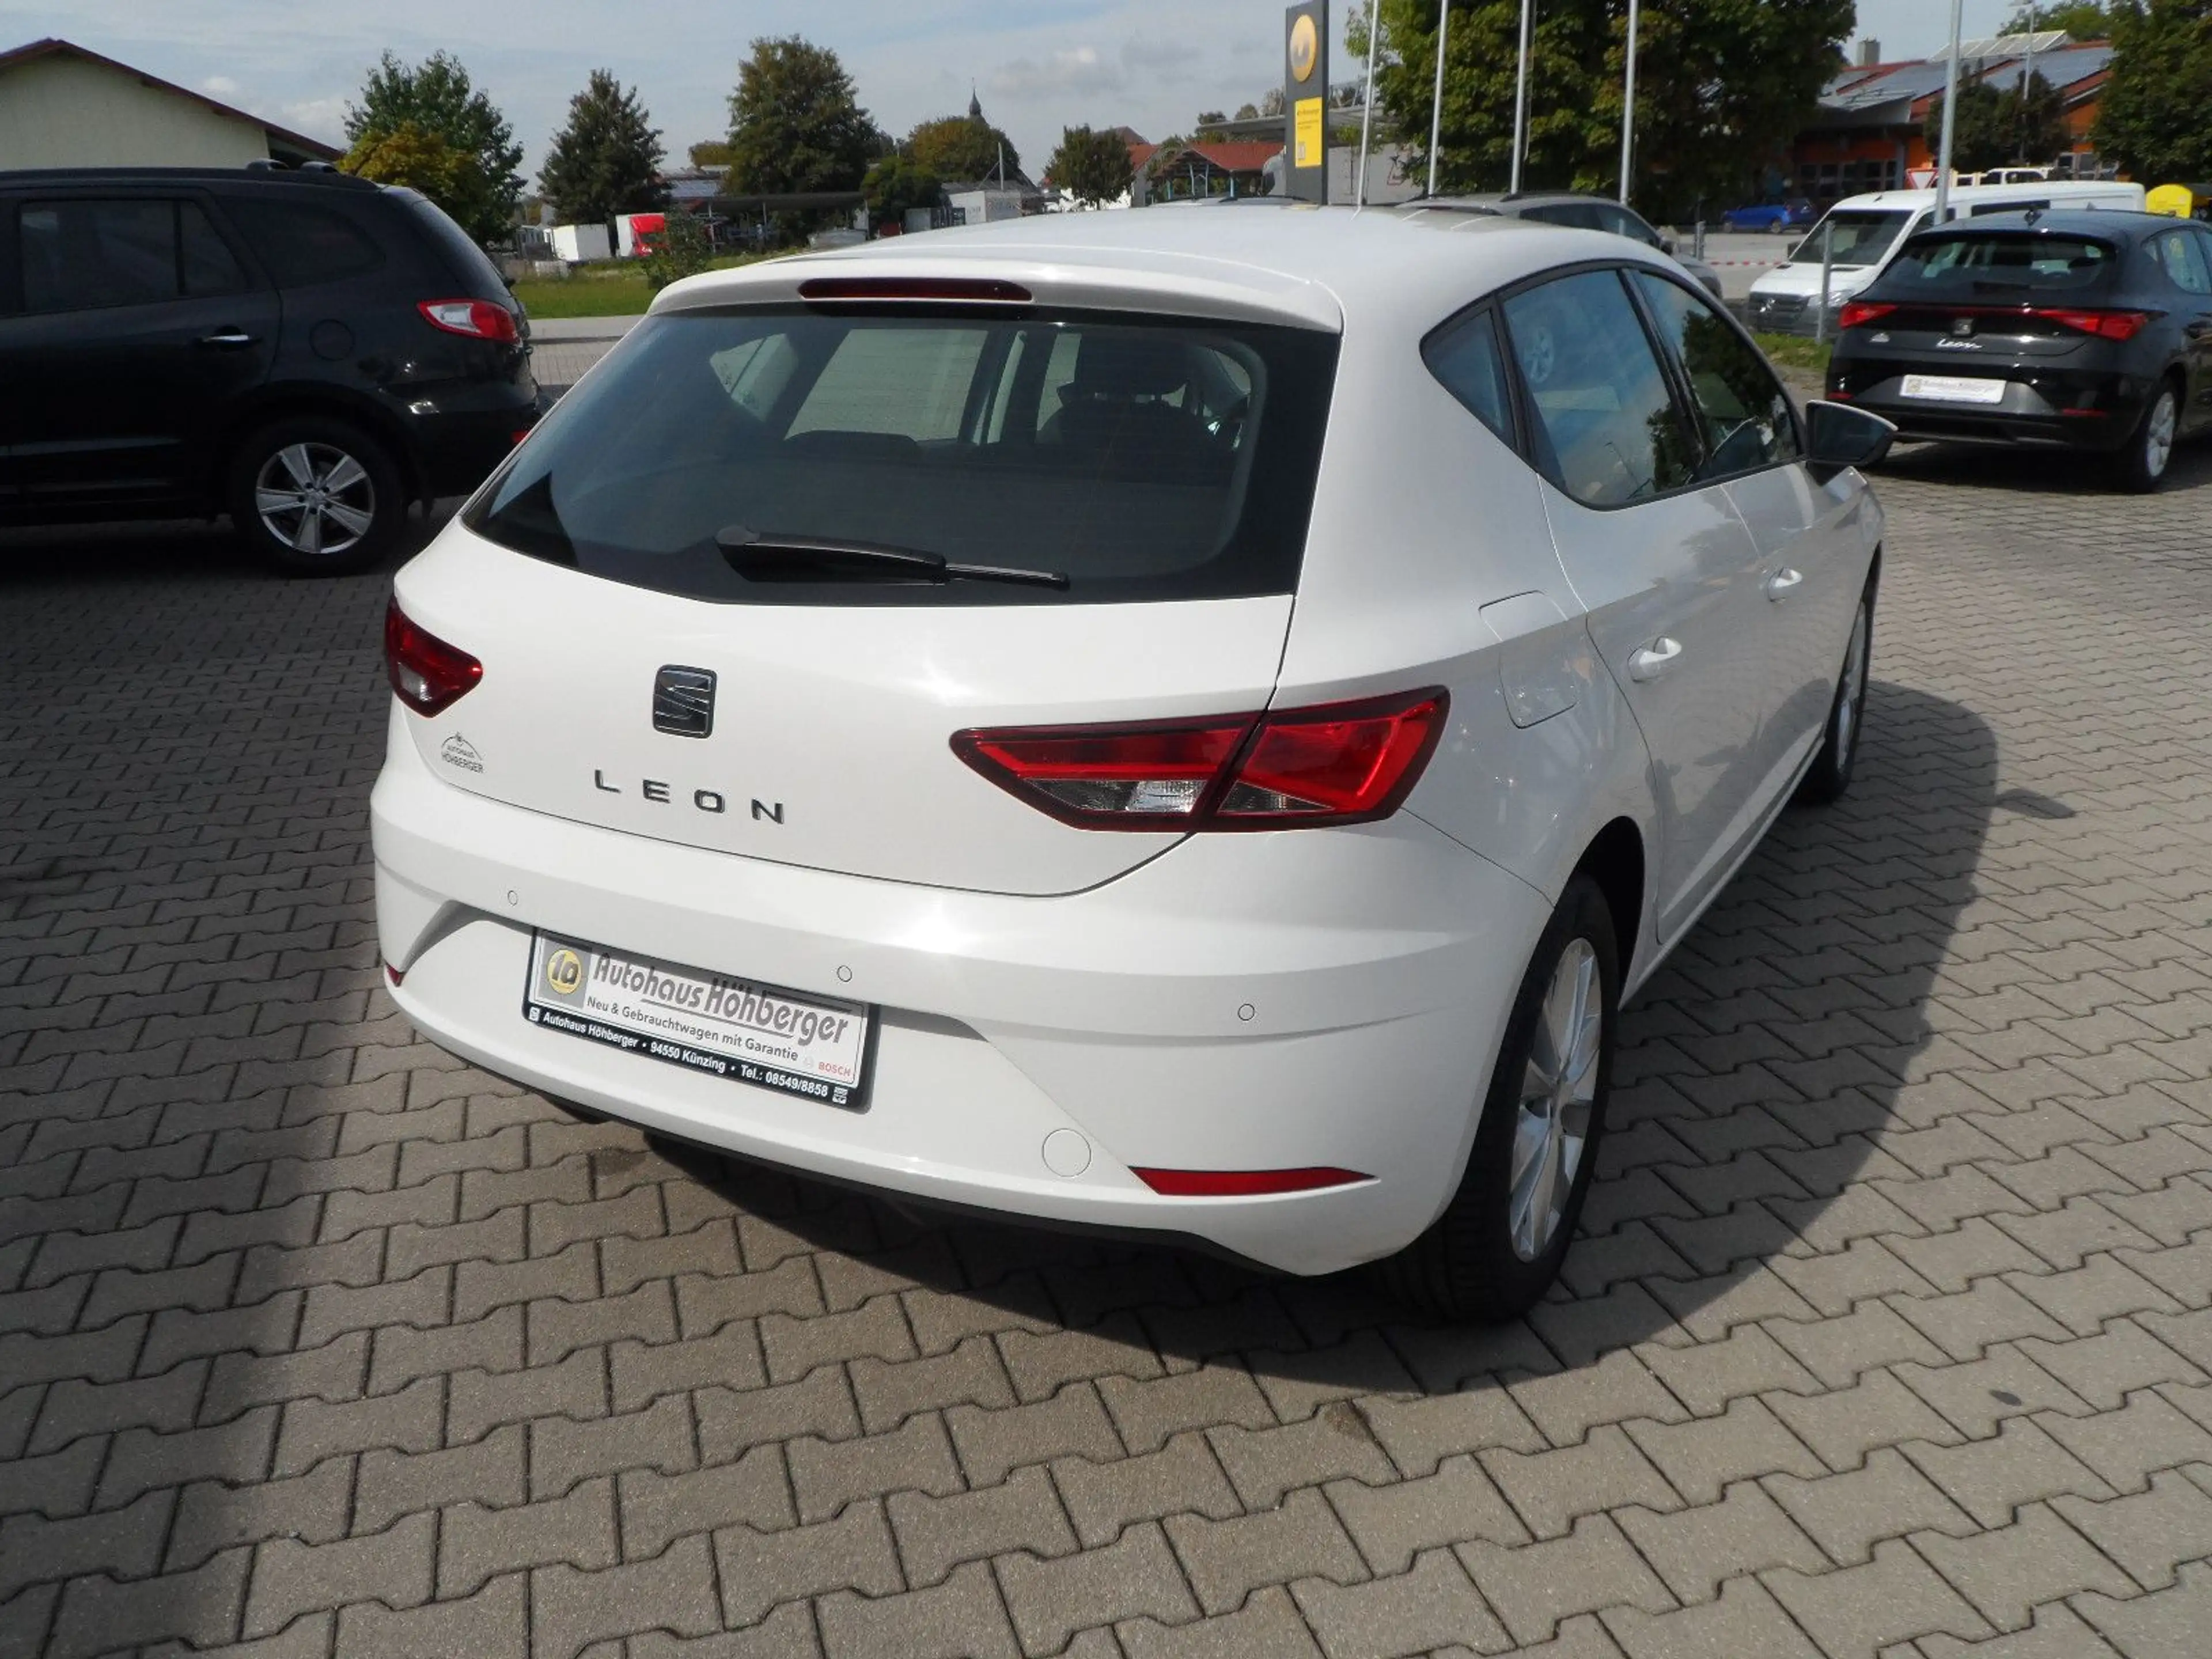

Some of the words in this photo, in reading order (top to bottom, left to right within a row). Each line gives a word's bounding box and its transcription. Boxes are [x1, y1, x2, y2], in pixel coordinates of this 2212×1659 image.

[594, 769, 784, 824] LEON
[587, 996, 608, 1012] Neu
[611, 1003, 619, 1016] &
[622, 1006, 719, 1040] Gebrauchtwagen
[721, 1033, 743, 1048] mit
[745, 1038, 799, 1062] Garantie
[593, 952, 704, 1008] Autohaus
[704, 978, 849, 1046] Höhberger
[543, 1012, 586, 1033] Autohaus
[588, 1024, 638, 1048] Höhberger
[650, 1041, 679, 1060] 94550
[681, 1048, 726, 1074] Künzing
[740, 1065, 763, 1081] Tel.:
[765, 1071, 828, 1097] 08549/8858
[818, 1061, 852, 1077] BOSCH
